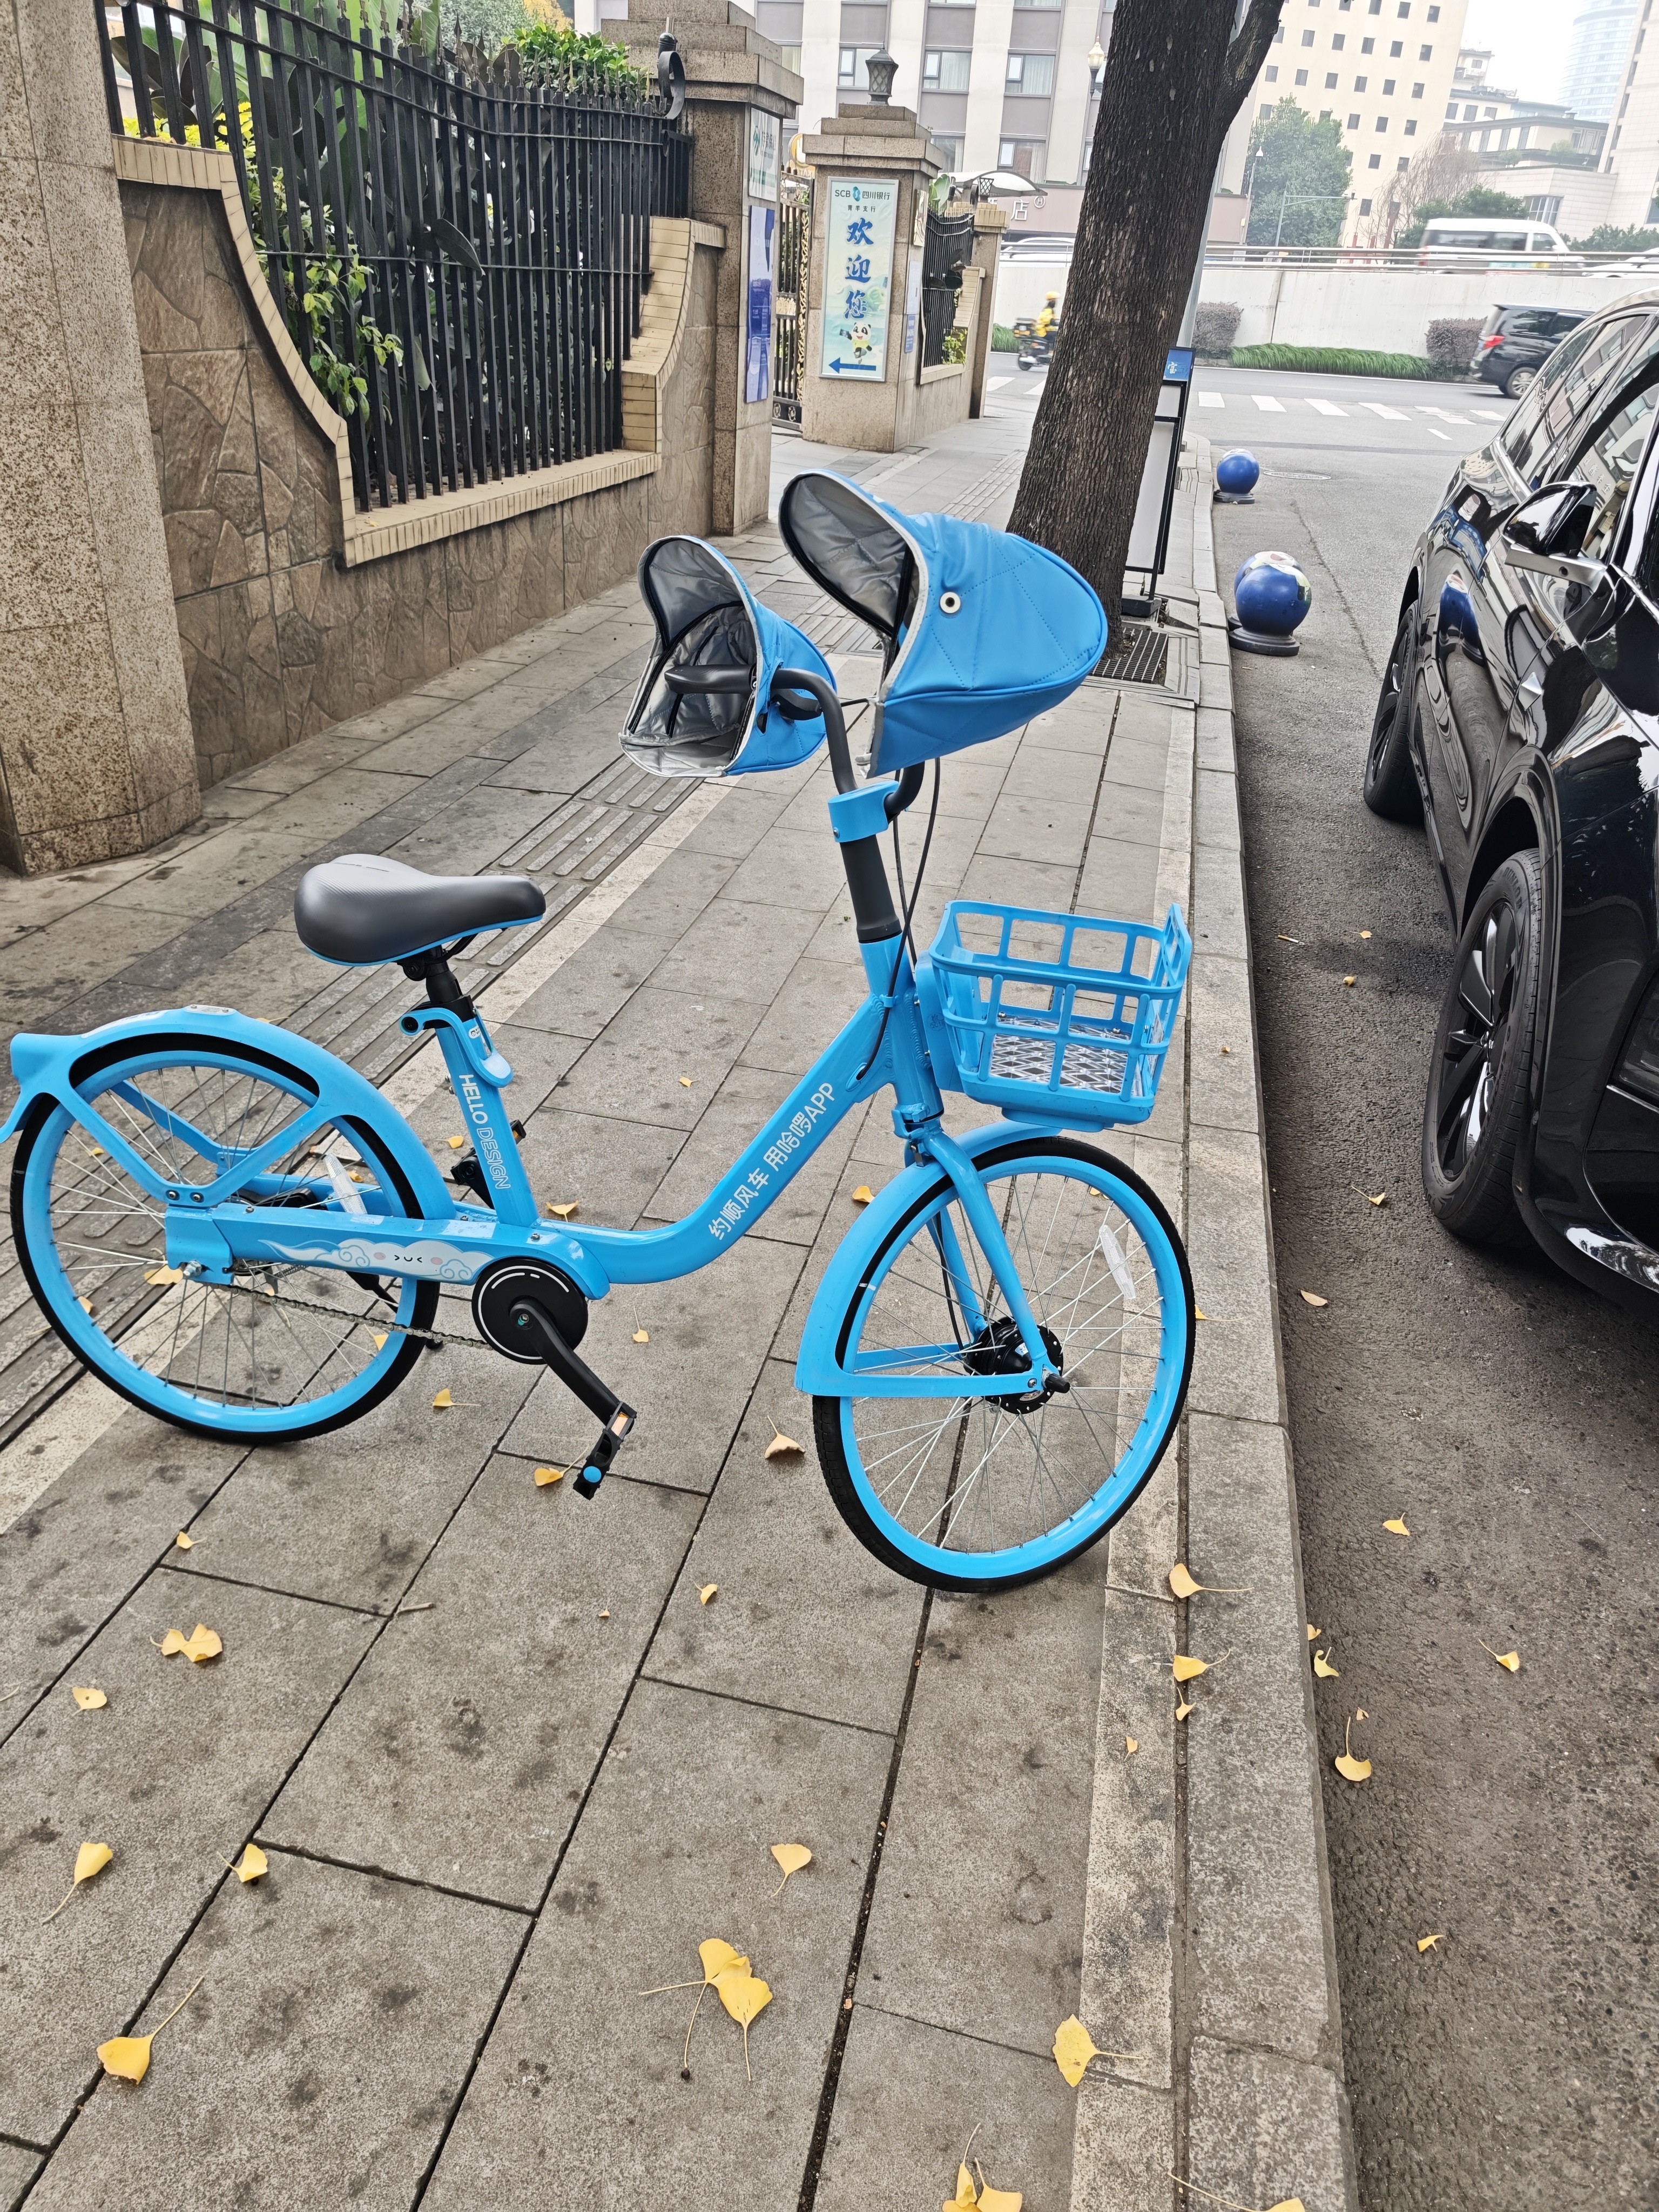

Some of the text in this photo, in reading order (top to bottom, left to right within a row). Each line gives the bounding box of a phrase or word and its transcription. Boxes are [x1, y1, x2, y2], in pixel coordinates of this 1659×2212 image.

[835, 190, 851, 198] SCB
[862, 191, 891, 200] 四川银行
[845, 217, 874, 319] 欢迎您
[459, 1074, 511, 1189] HELLO DESIGN
[708, 1082, 835, 1240] 约顺风车 用哈啰APP
